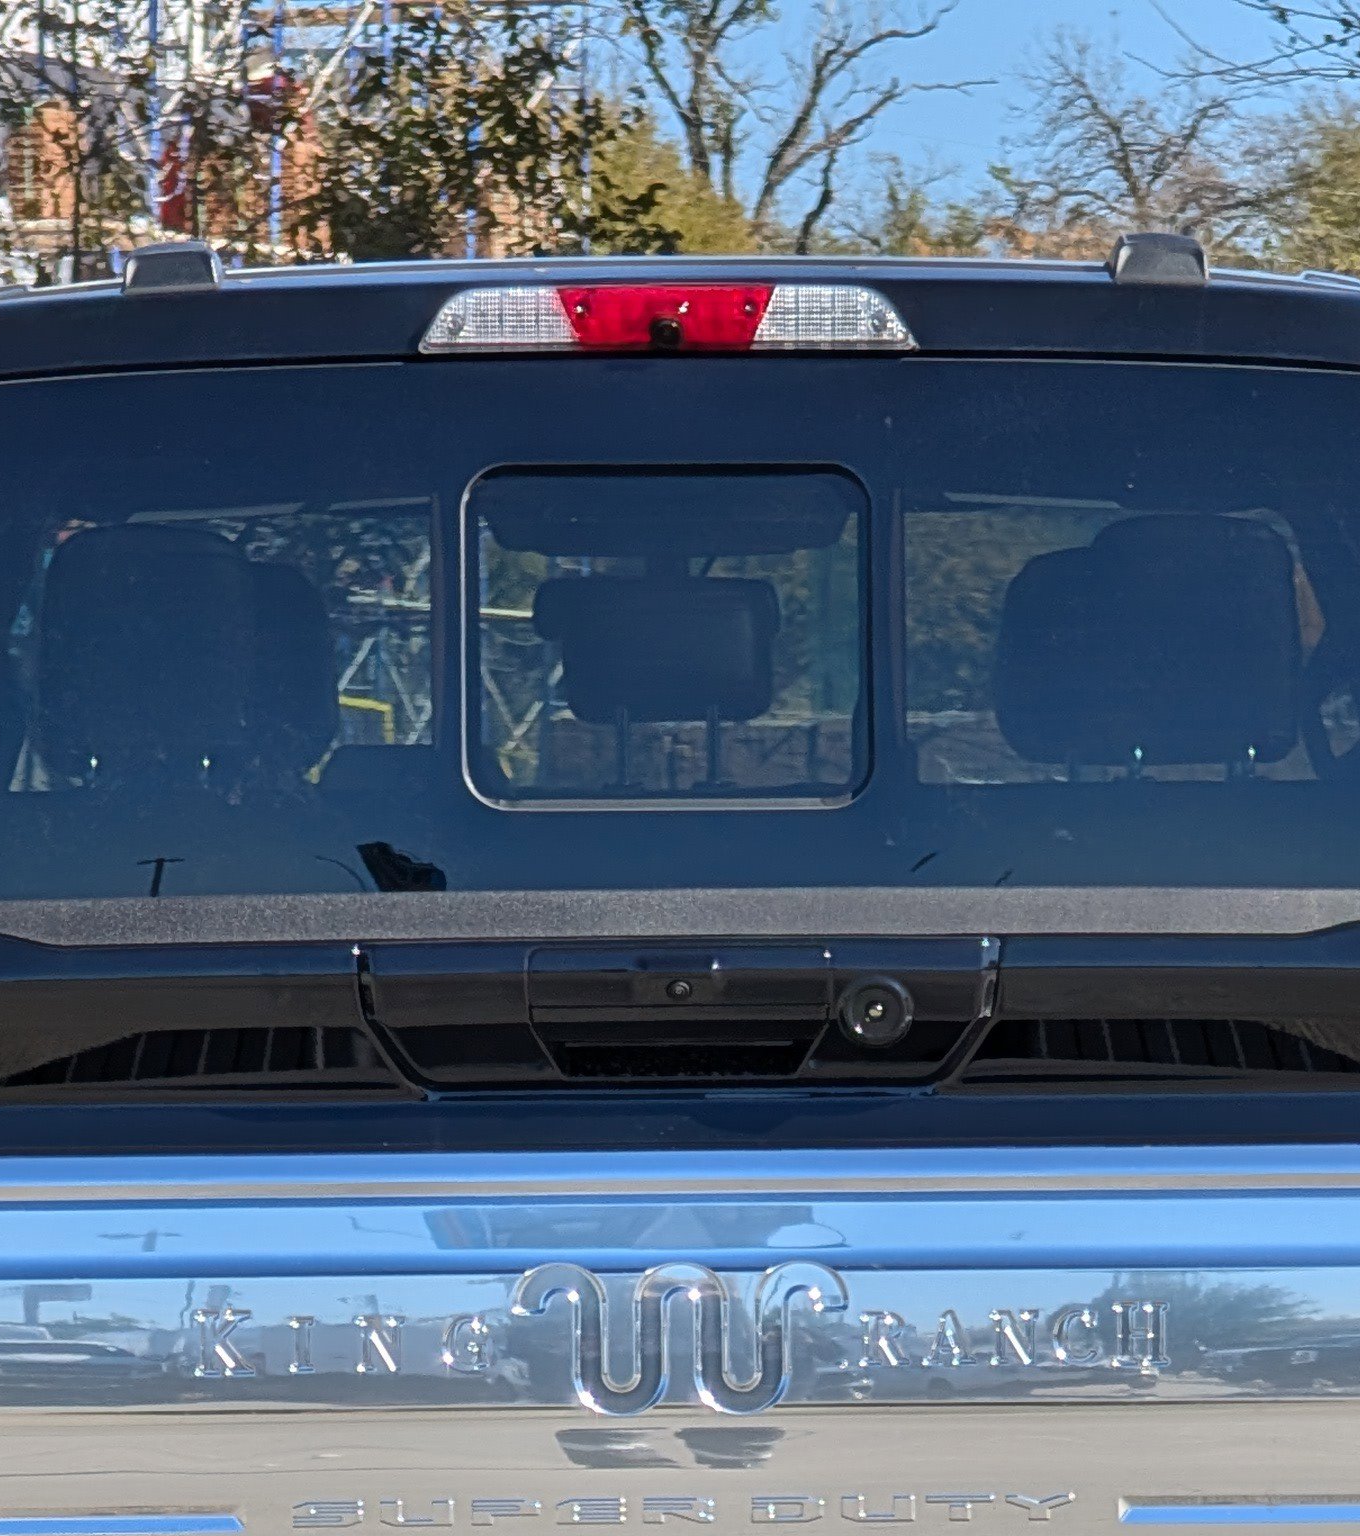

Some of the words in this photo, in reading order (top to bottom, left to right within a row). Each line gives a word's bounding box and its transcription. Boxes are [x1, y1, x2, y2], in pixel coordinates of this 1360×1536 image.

[192, 1308, 490, 1377] KING
[858, 1301, 1171, 1368] RANCH
[292, 1497, 713, 1527] SUPER
[751, 1492, 1077, 1522] DUTY
